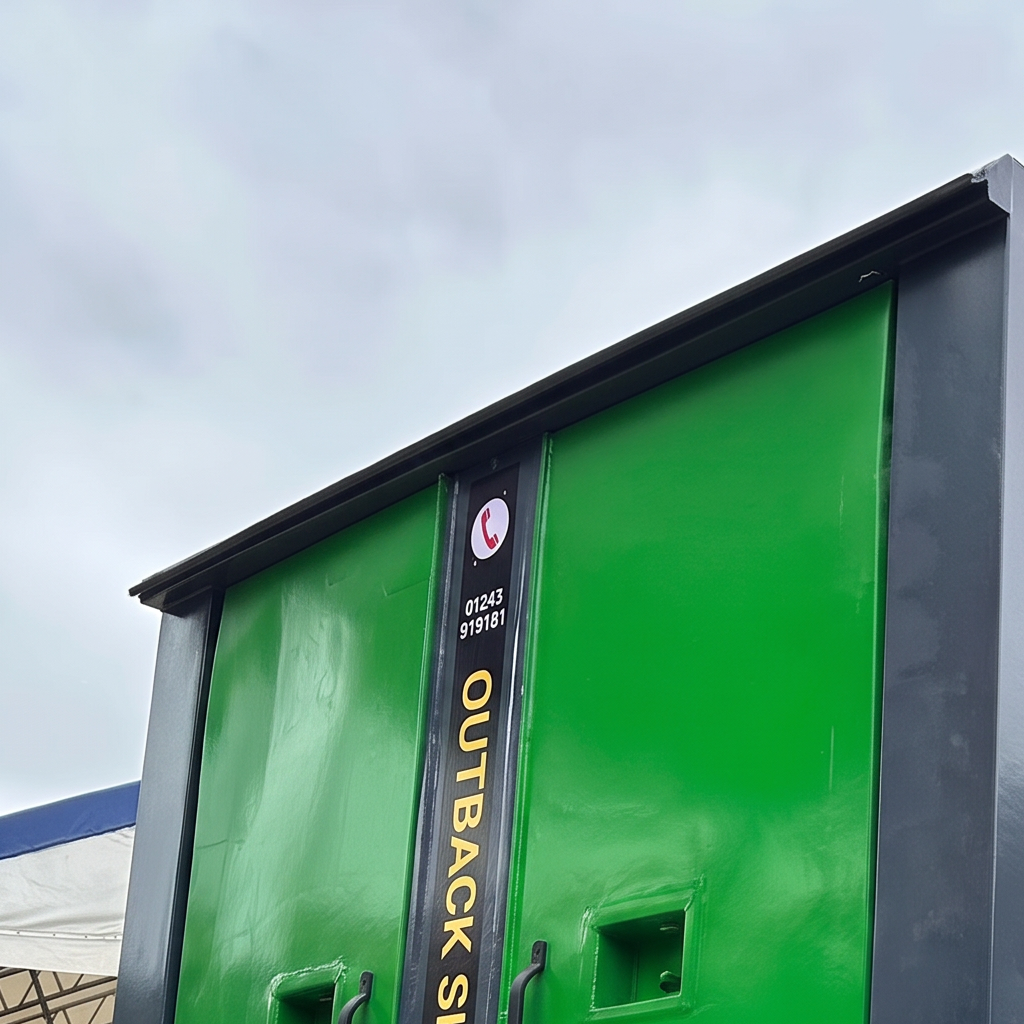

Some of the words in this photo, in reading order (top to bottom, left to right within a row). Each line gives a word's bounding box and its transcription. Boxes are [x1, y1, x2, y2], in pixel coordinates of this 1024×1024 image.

[464, 587, 504, 617] 01243
[459, 607, 506, 640] 919181
[441, 669, 493, 958] OUTBACK
